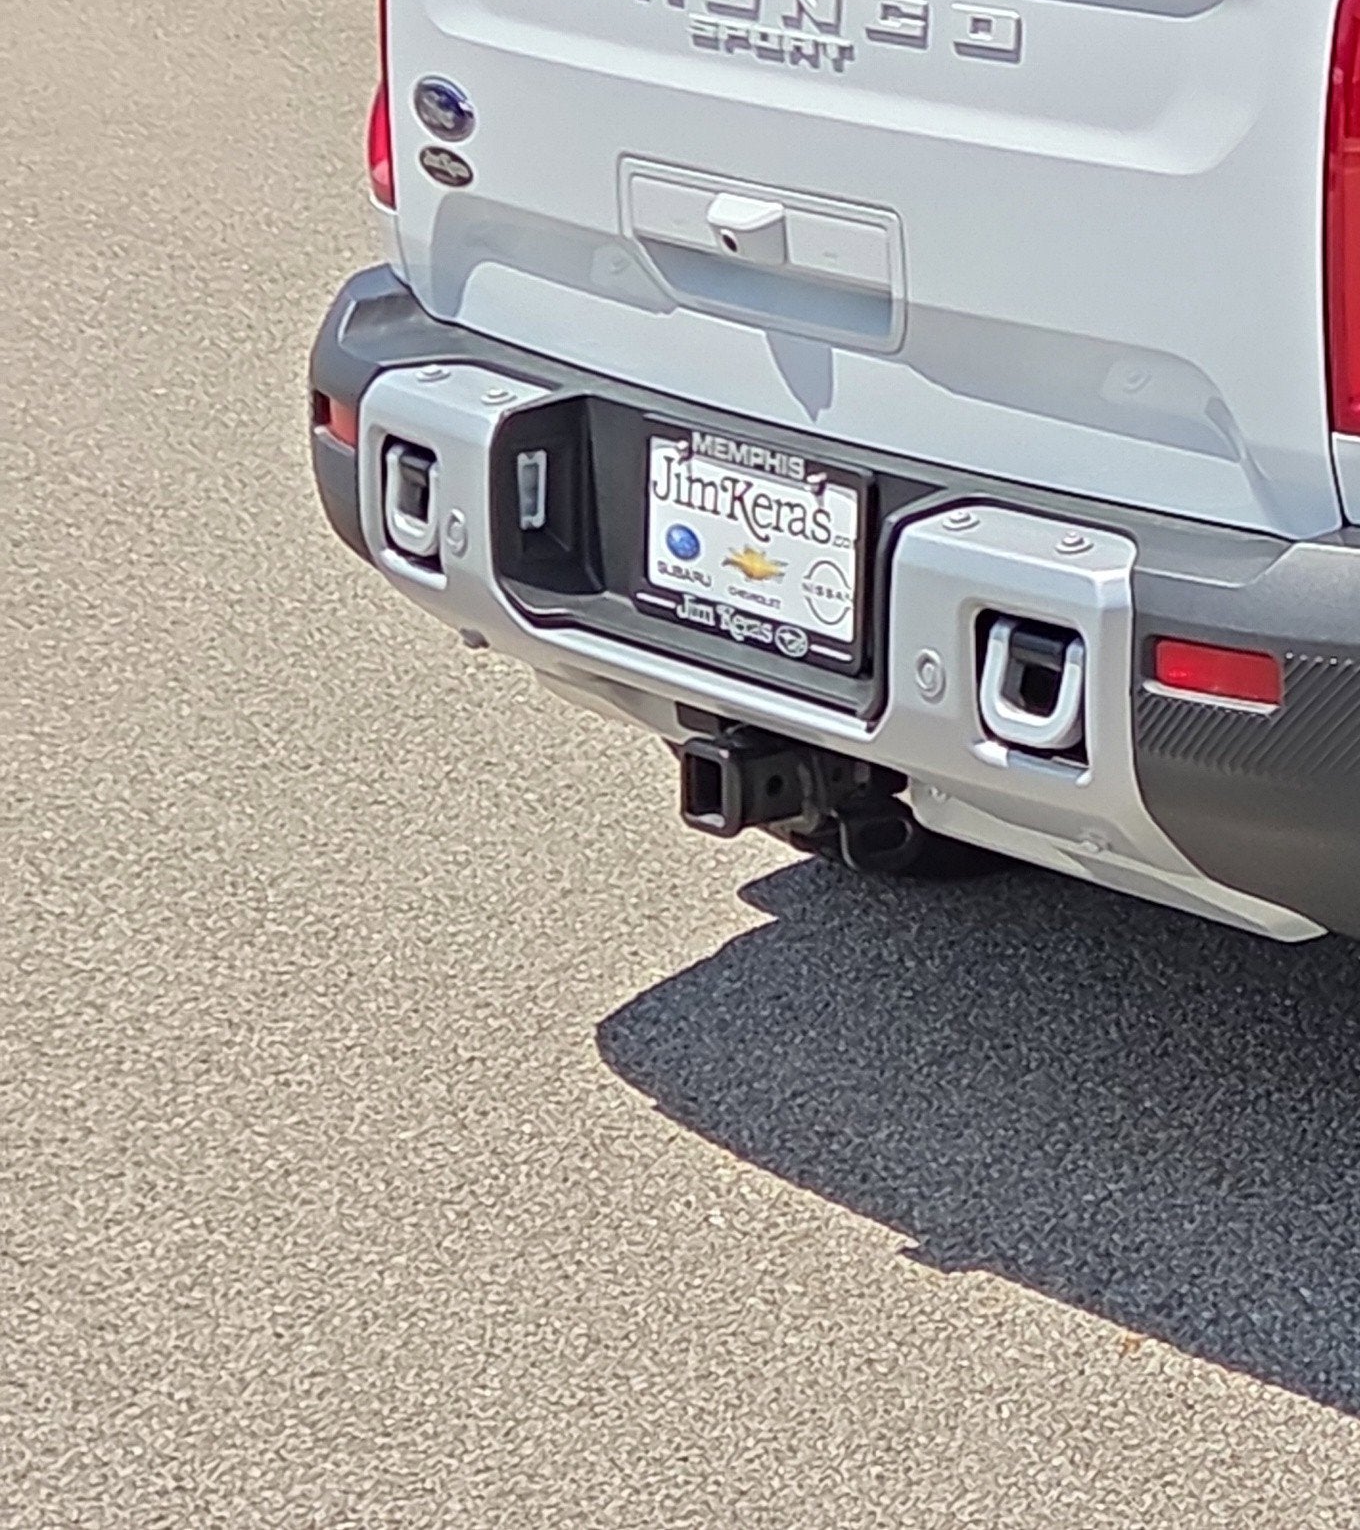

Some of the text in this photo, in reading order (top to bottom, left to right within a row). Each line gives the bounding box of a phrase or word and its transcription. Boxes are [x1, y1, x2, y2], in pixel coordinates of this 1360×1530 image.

[686, 11, 856, 73] SPORT
[691, 431, 806, 481] MEMPHIS
[657, 560, 713, 588] SUBARU
[676, 592, 716, 627] Jim
